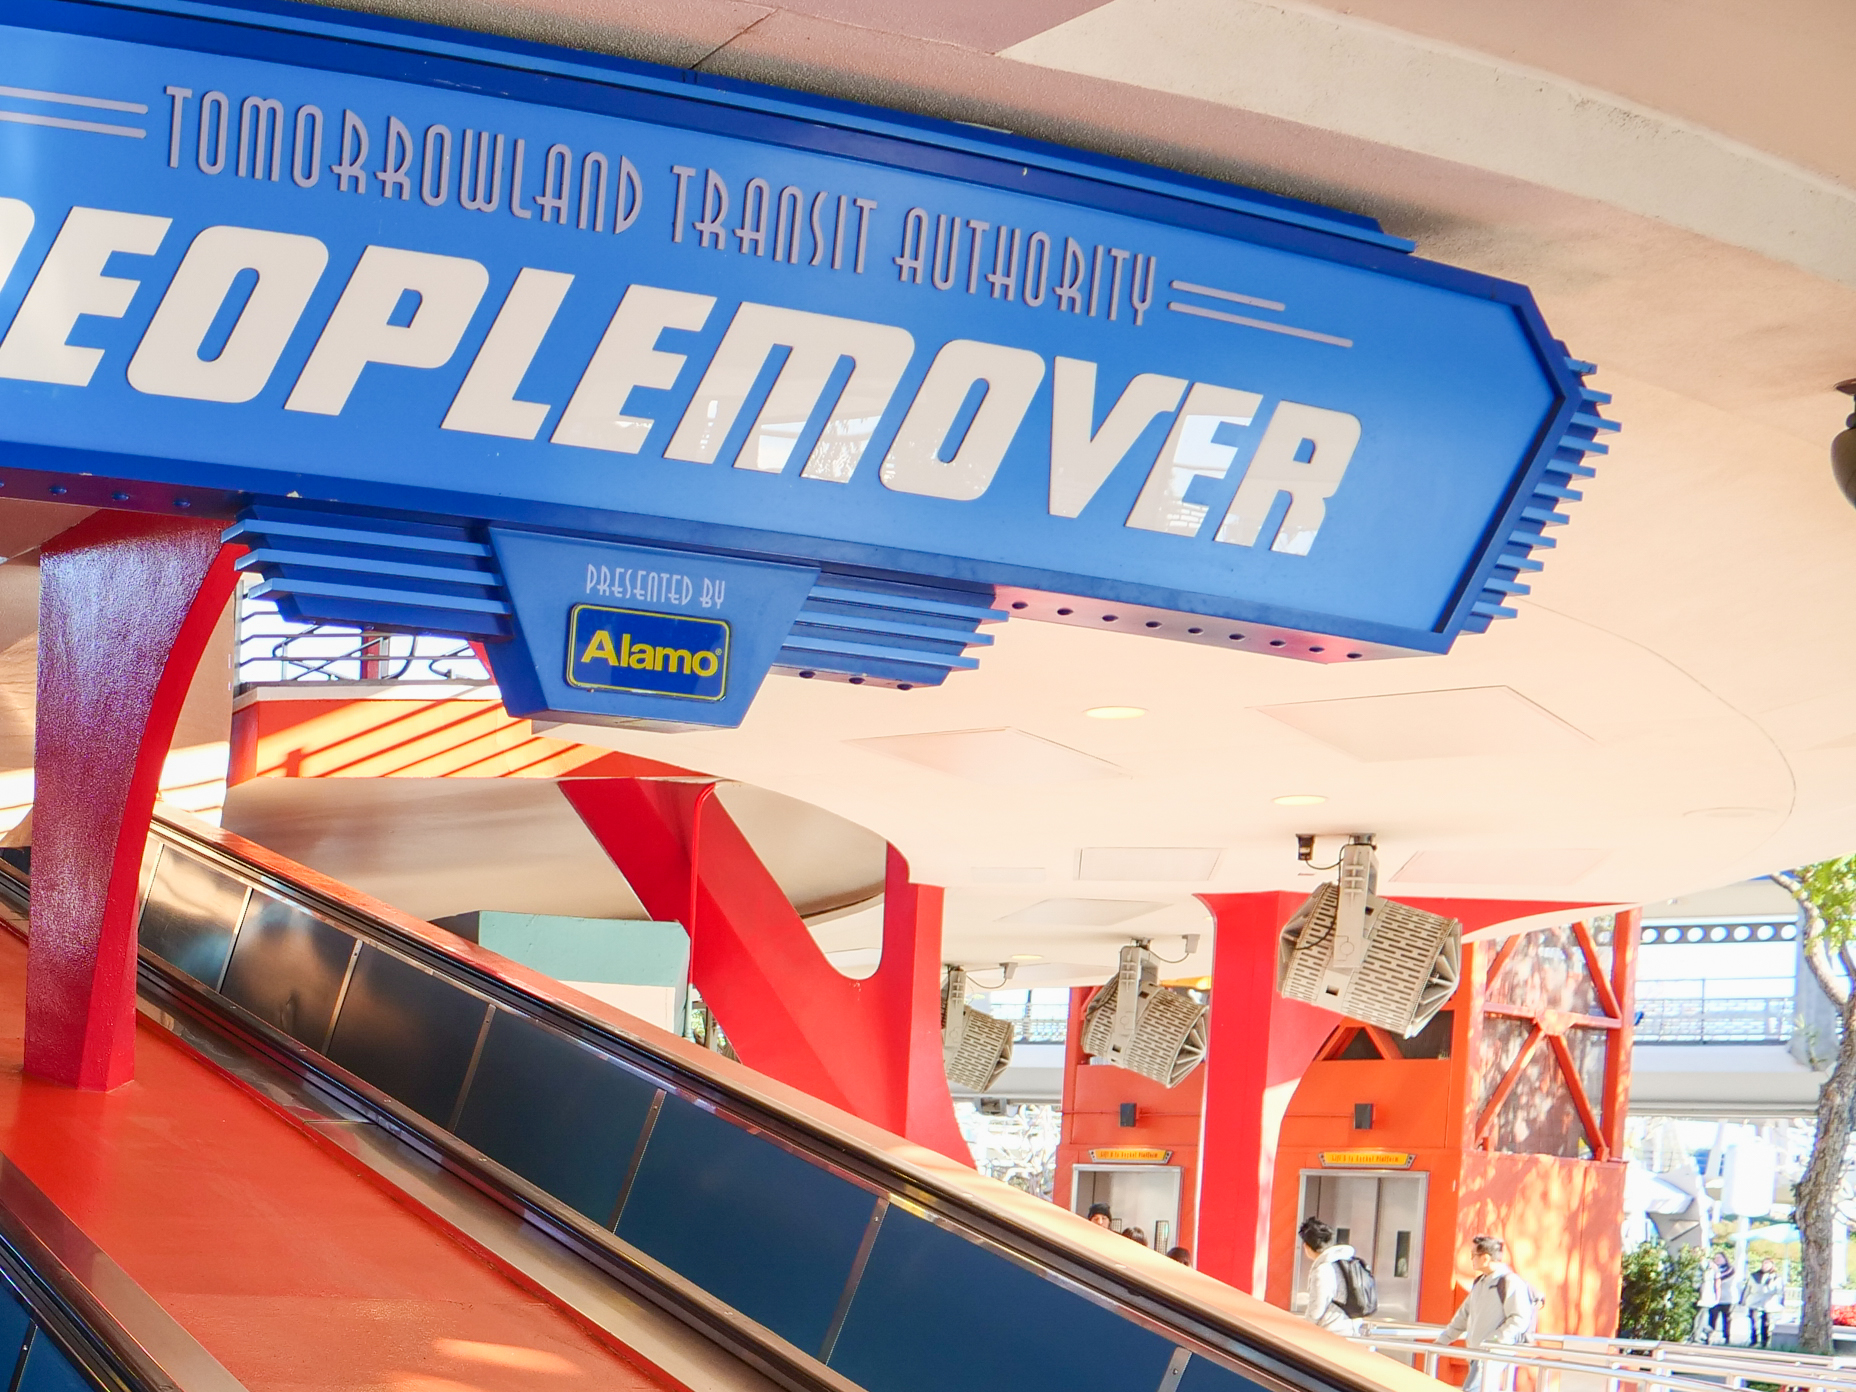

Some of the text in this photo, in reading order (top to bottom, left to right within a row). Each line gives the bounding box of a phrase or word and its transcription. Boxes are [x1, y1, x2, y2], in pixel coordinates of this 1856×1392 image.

[164, 86, 1157, 326] TOMORROWLAND TRANSIT AUTHORITY
[586, 563, 725, 609] PRESENTED BY
